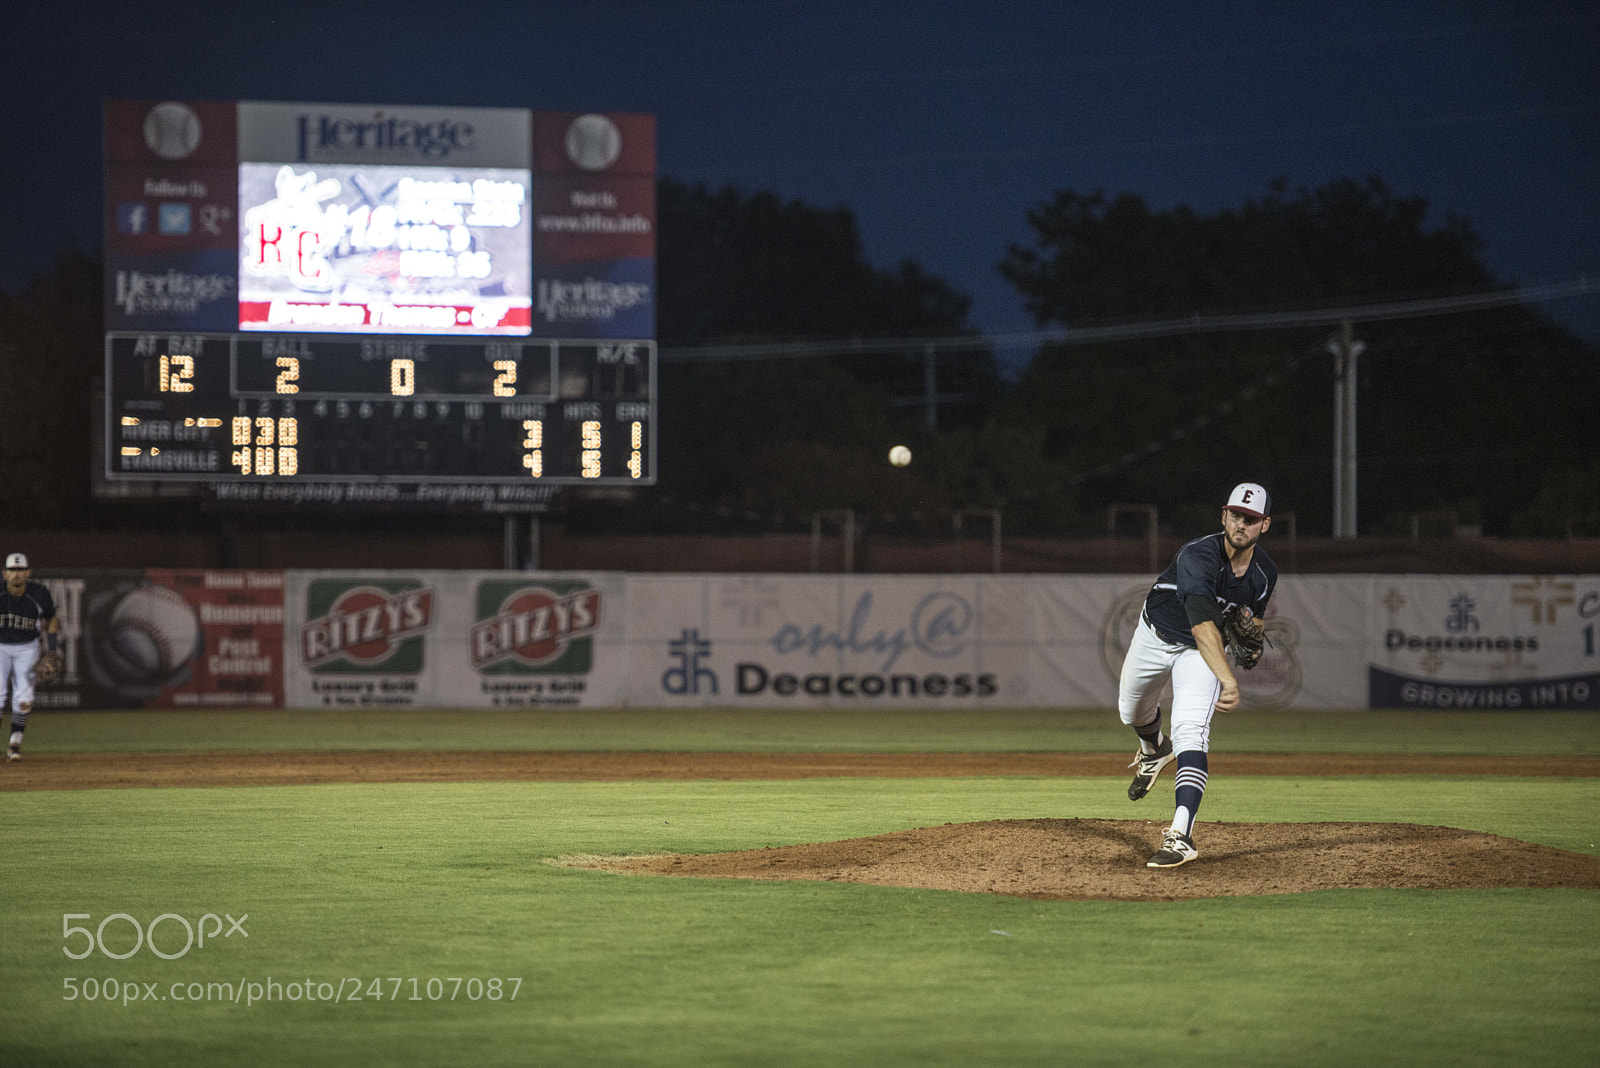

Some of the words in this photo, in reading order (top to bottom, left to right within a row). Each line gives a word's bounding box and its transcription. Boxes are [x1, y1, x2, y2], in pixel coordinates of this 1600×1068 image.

[297, 112, 478, 162] Heritage
[115, 269, 234, 306] Heritage
[537, 276, 651, 313] Heritage
[133, 335, 157, 357] AT
[167, 335, 205, 357] BAT
[262, 337, 315, 360] BALL
[360, 340, 429, 362] STRIKE
[485, 342, 522, 362] OUT
[159, 355, 194, 392] 12
[276, 356, 300, 394] 2
[391, 358, 415, 396] 0
[493, 360, 517, 397] 2
[314, 402, 328, 418] 4
[501, 403, 547, 420] RUNS
[564, 404, 601, 421] HITS
[122, 420, 172, 441] RIVER
[523, 420, 543, 448] 3
[631, 421, 642, 449] 1
[121, 449, 219, 471] EVANSVILLE
[523, 449, 543, 478] 4
[1241, 489, 1255, 504] E
[1386, 629, 1538, 650] Deaconess
[735, 662, 998, 696] Deaconess
[1401, 682, 1521, 707] GROWING
[1529, 682, 1590, 707] INTO
